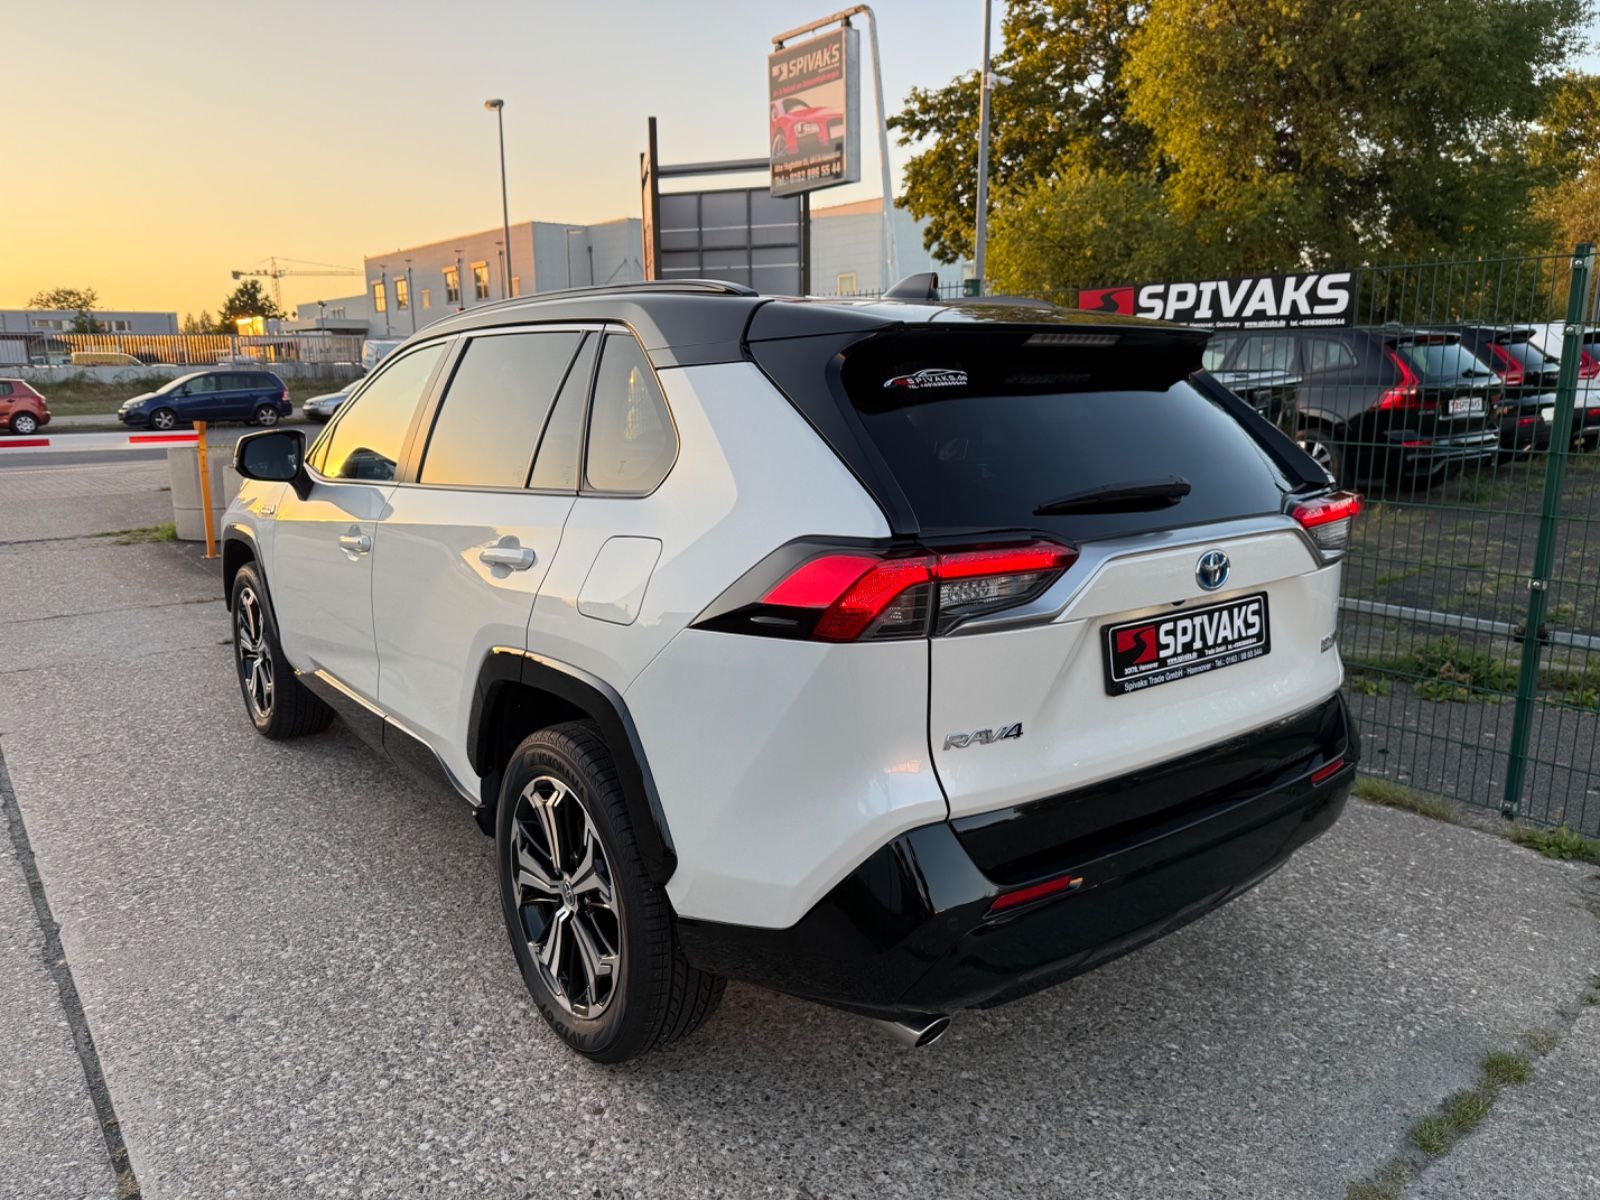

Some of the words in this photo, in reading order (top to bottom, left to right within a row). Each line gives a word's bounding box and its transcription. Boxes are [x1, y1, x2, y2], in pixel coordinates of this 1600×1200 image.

[788, 43, 840, 78] SPIVAKS
[1136, 272, 1351, 321] SPIVAKS
[1216, 320, 1240, 328] Germany
[1159, 603, 1260, 658] SPIVAKS
[1124, 678, 1148, 692] Spivaks
[1149, 674, 1165, 684] Trade
[1165, 668, 1183, 681] GmbH
[1187, 663, 1212, 675] Hannover
[943, 720, 1024, 751] RAV4
